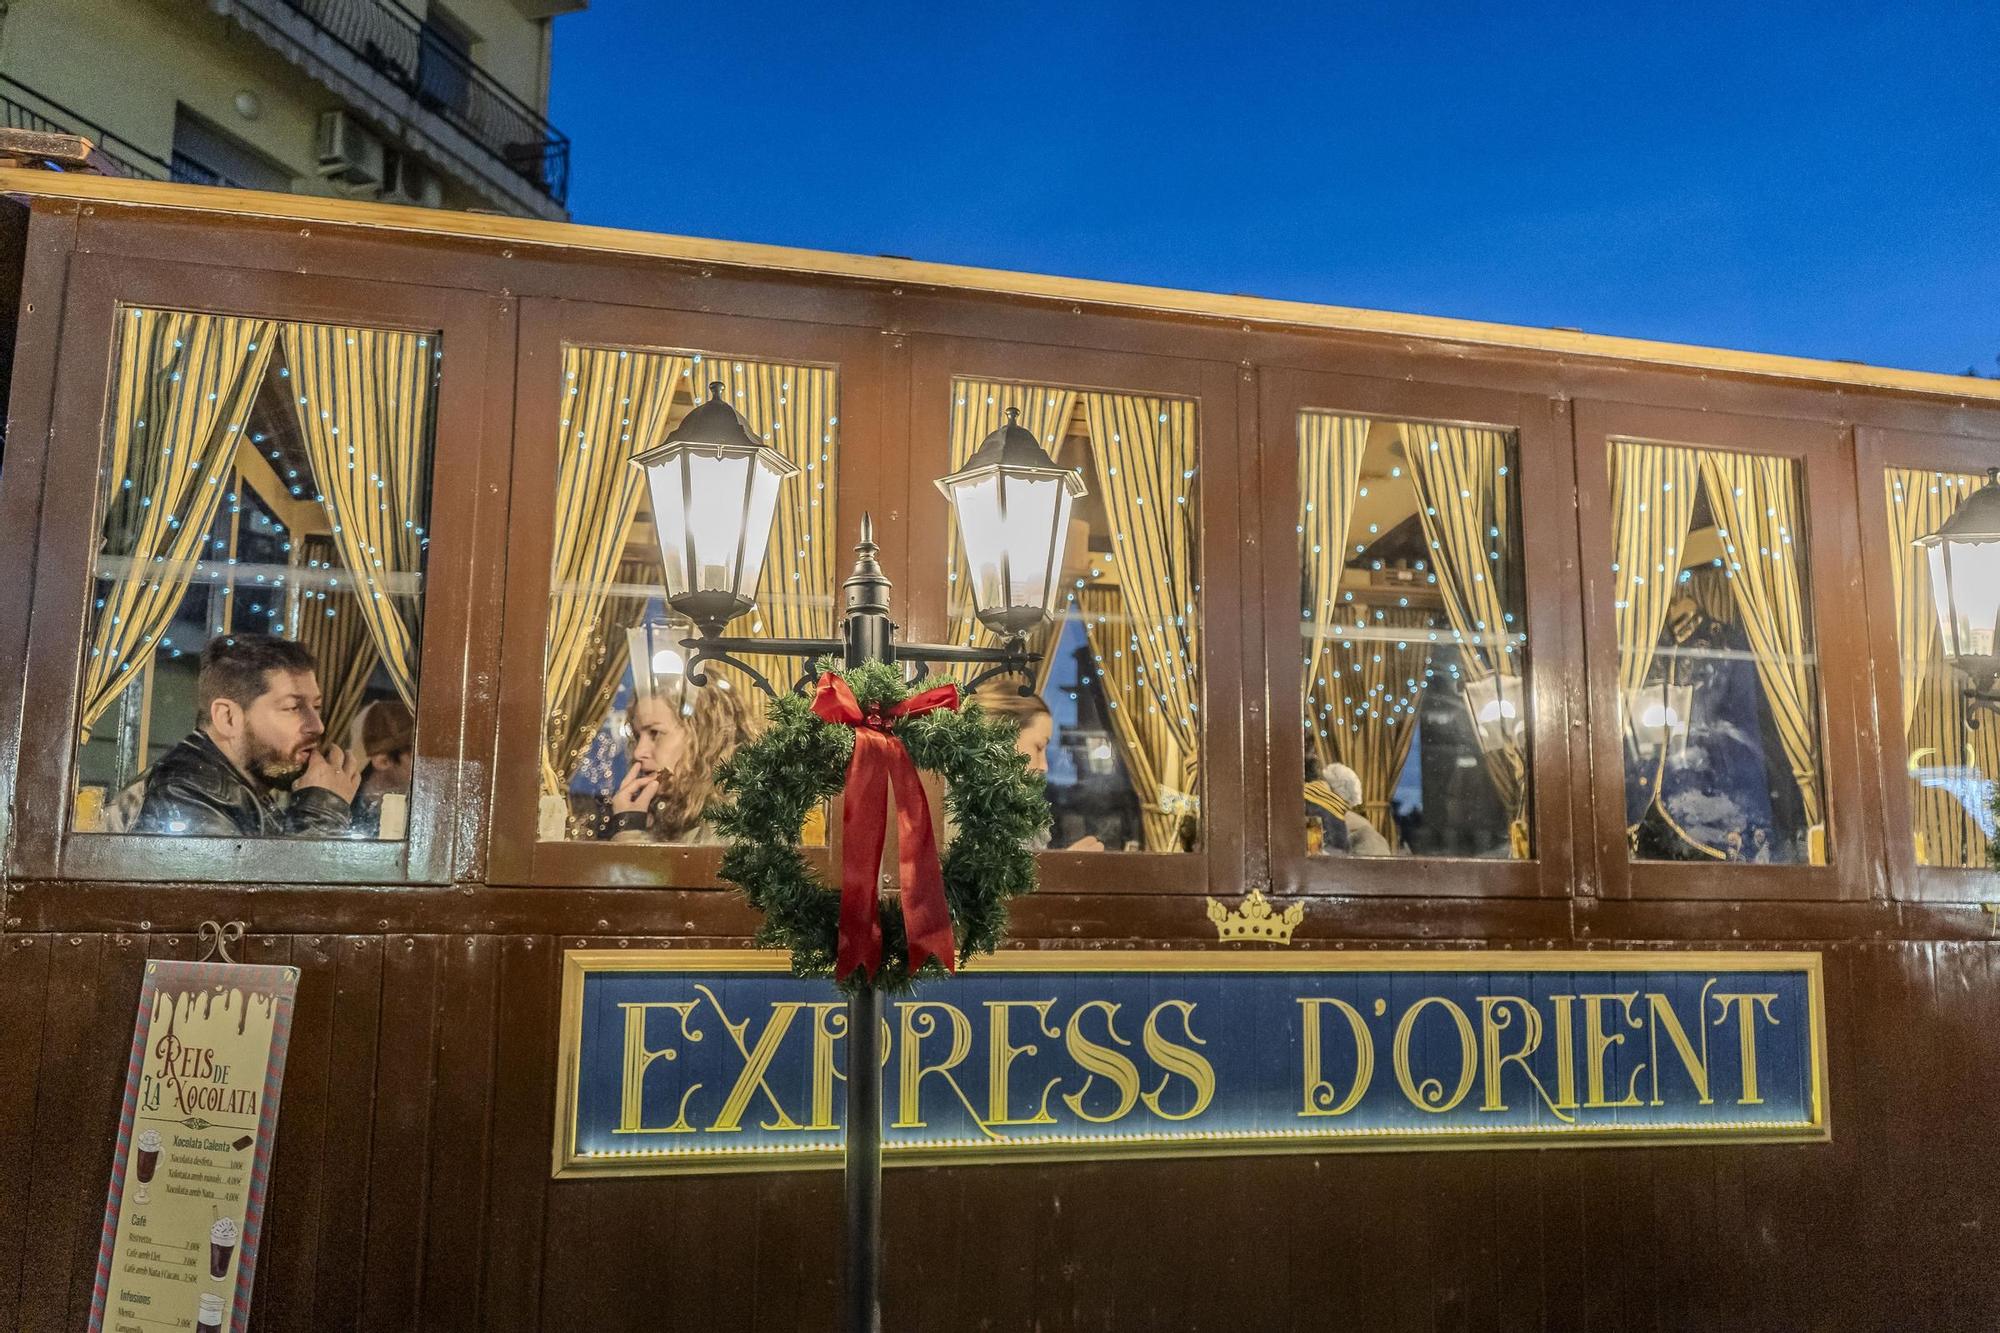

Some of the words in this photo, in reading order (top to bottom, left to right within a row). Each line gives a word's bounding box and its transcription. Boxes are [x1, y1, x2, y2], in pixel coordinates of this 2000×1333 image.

[155, 1034, 214, 1080] REIS
[212, 1065, 231, 1085] DE
[611, 983, 1216, 1141] EXPRESS
[1296, 978, 1780, 1122] D'ORIENT
[141, 1075, 161, 1112] LA
[166, 1077, 257, 1115] XOCOLATA
[173, 1135, 202, 1149] Xocolata
[203, 1138, 231, 1152] Calenta
